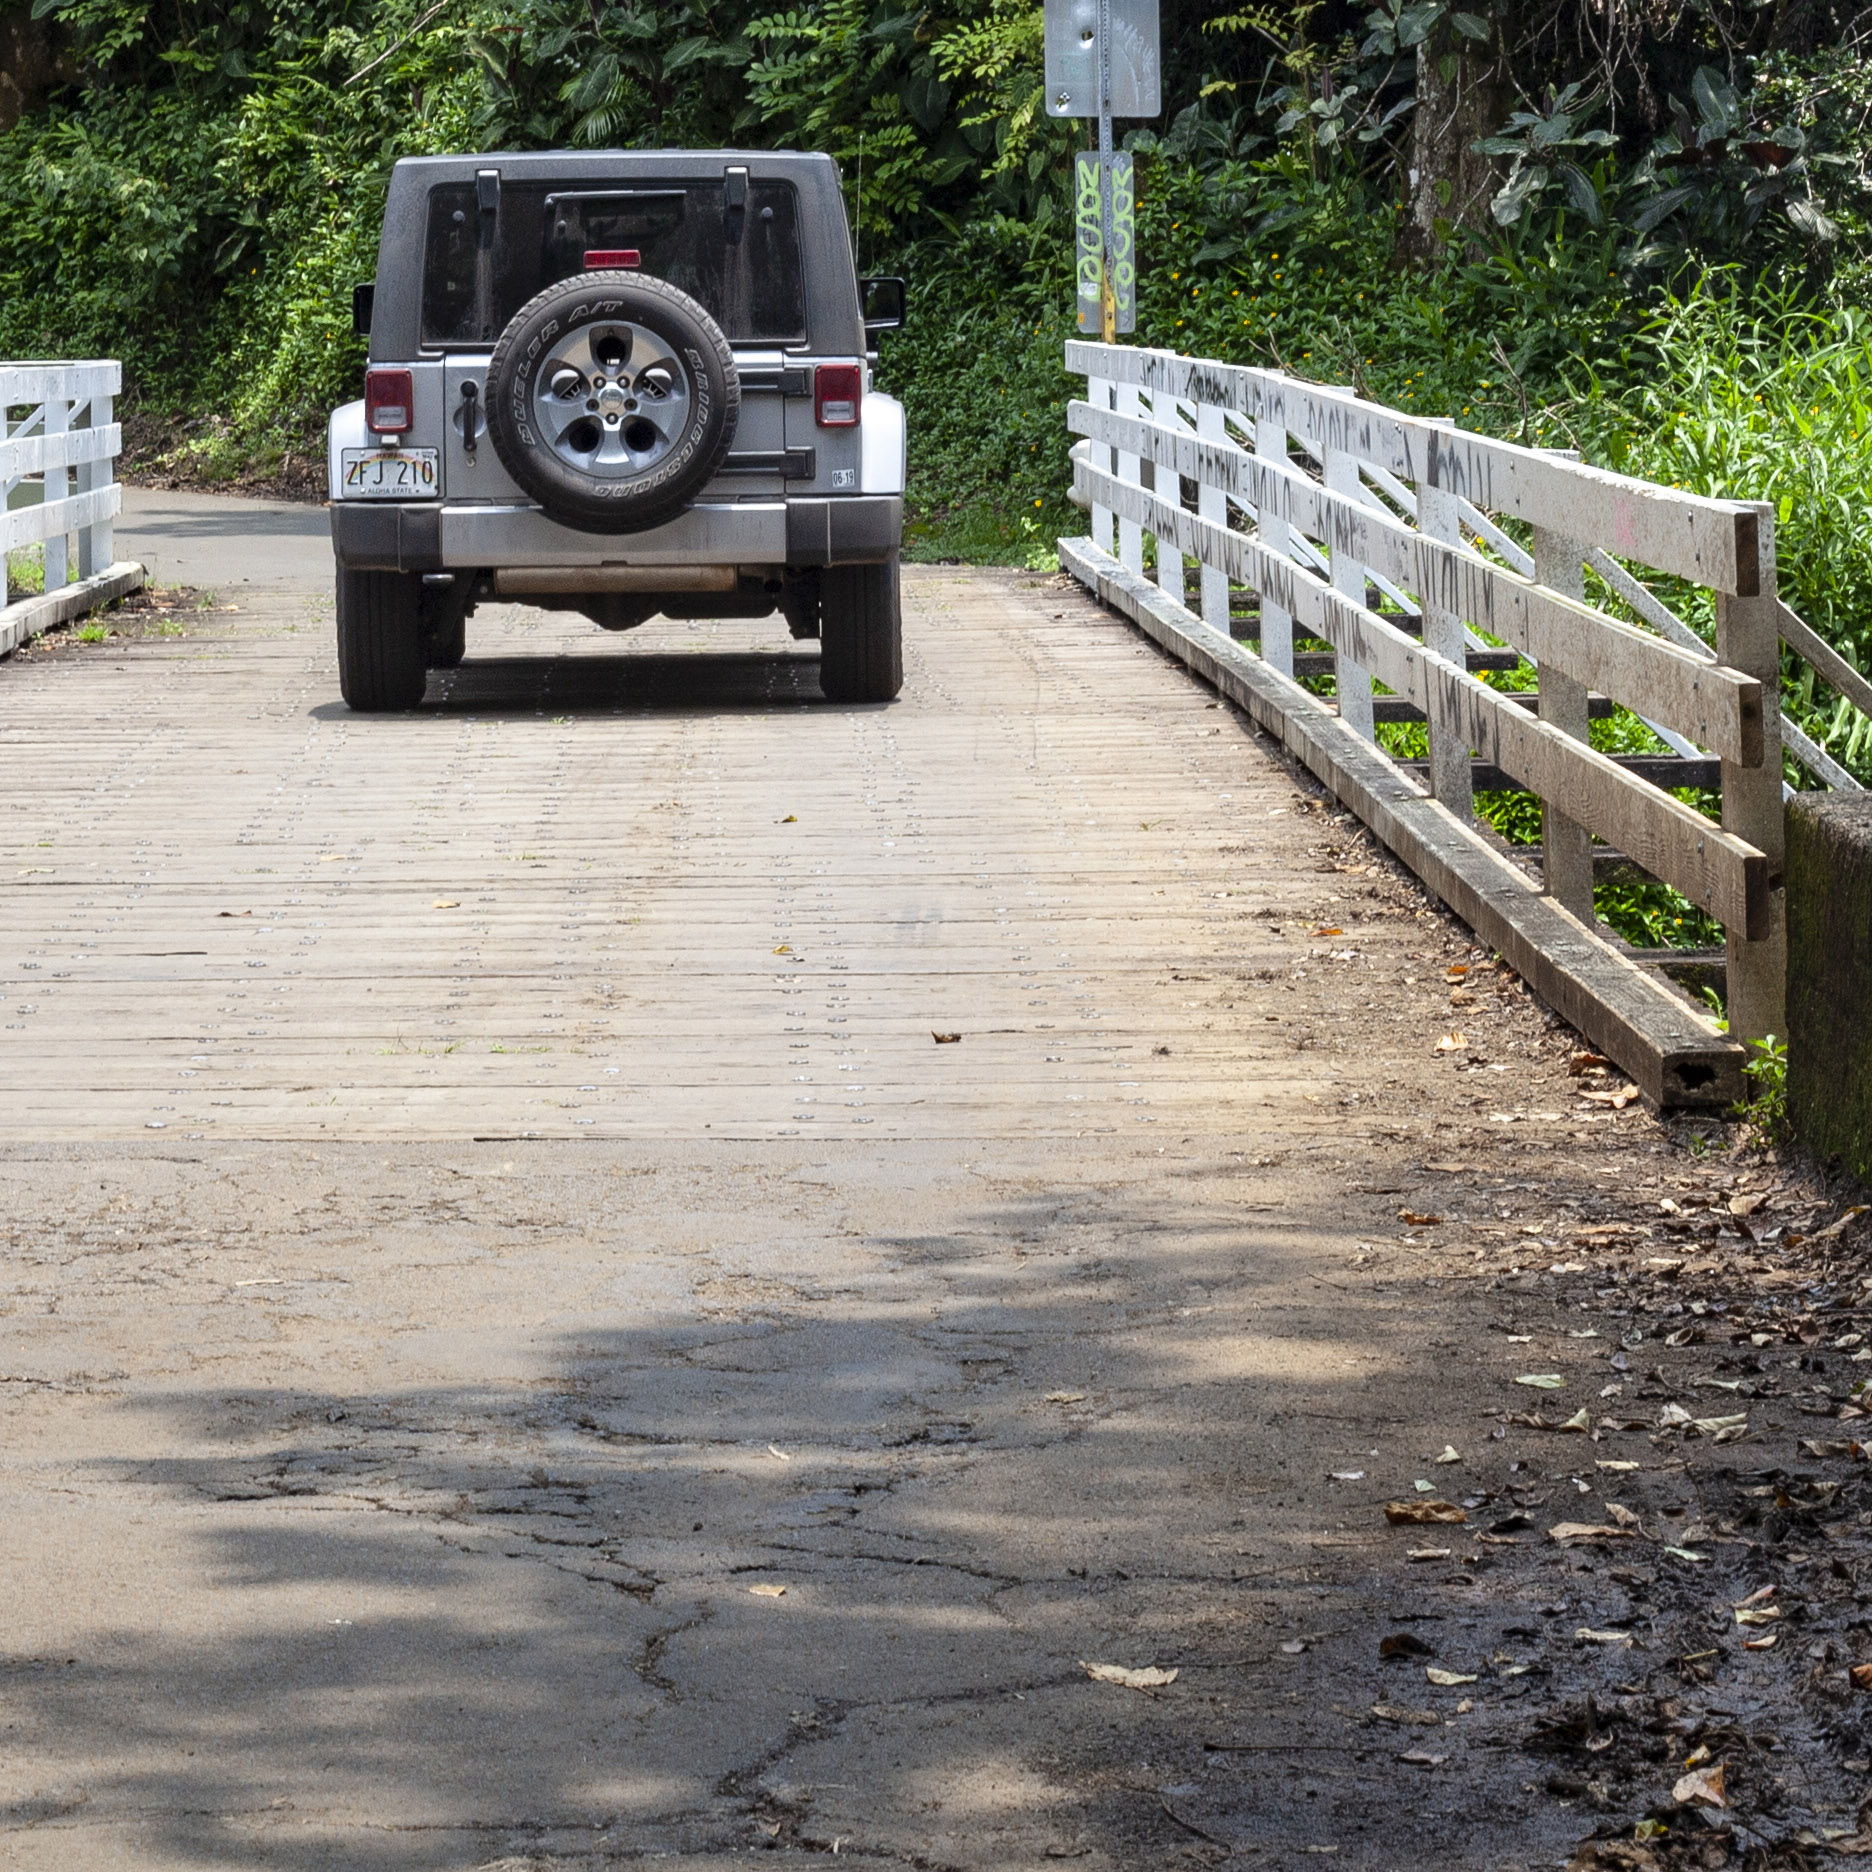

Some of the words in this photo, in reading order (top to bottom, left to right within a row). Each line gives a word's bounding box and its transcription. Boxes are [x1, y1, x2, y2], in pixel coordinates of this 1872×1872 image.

[568, 300, 624, 324] A/T
[593, 347, 710, 498] BRIDGESTONE
[346, 460, 384, 486] ZFJ
[396, 460, 434, 486] 210
[392, 487, 413, 495] STATE
